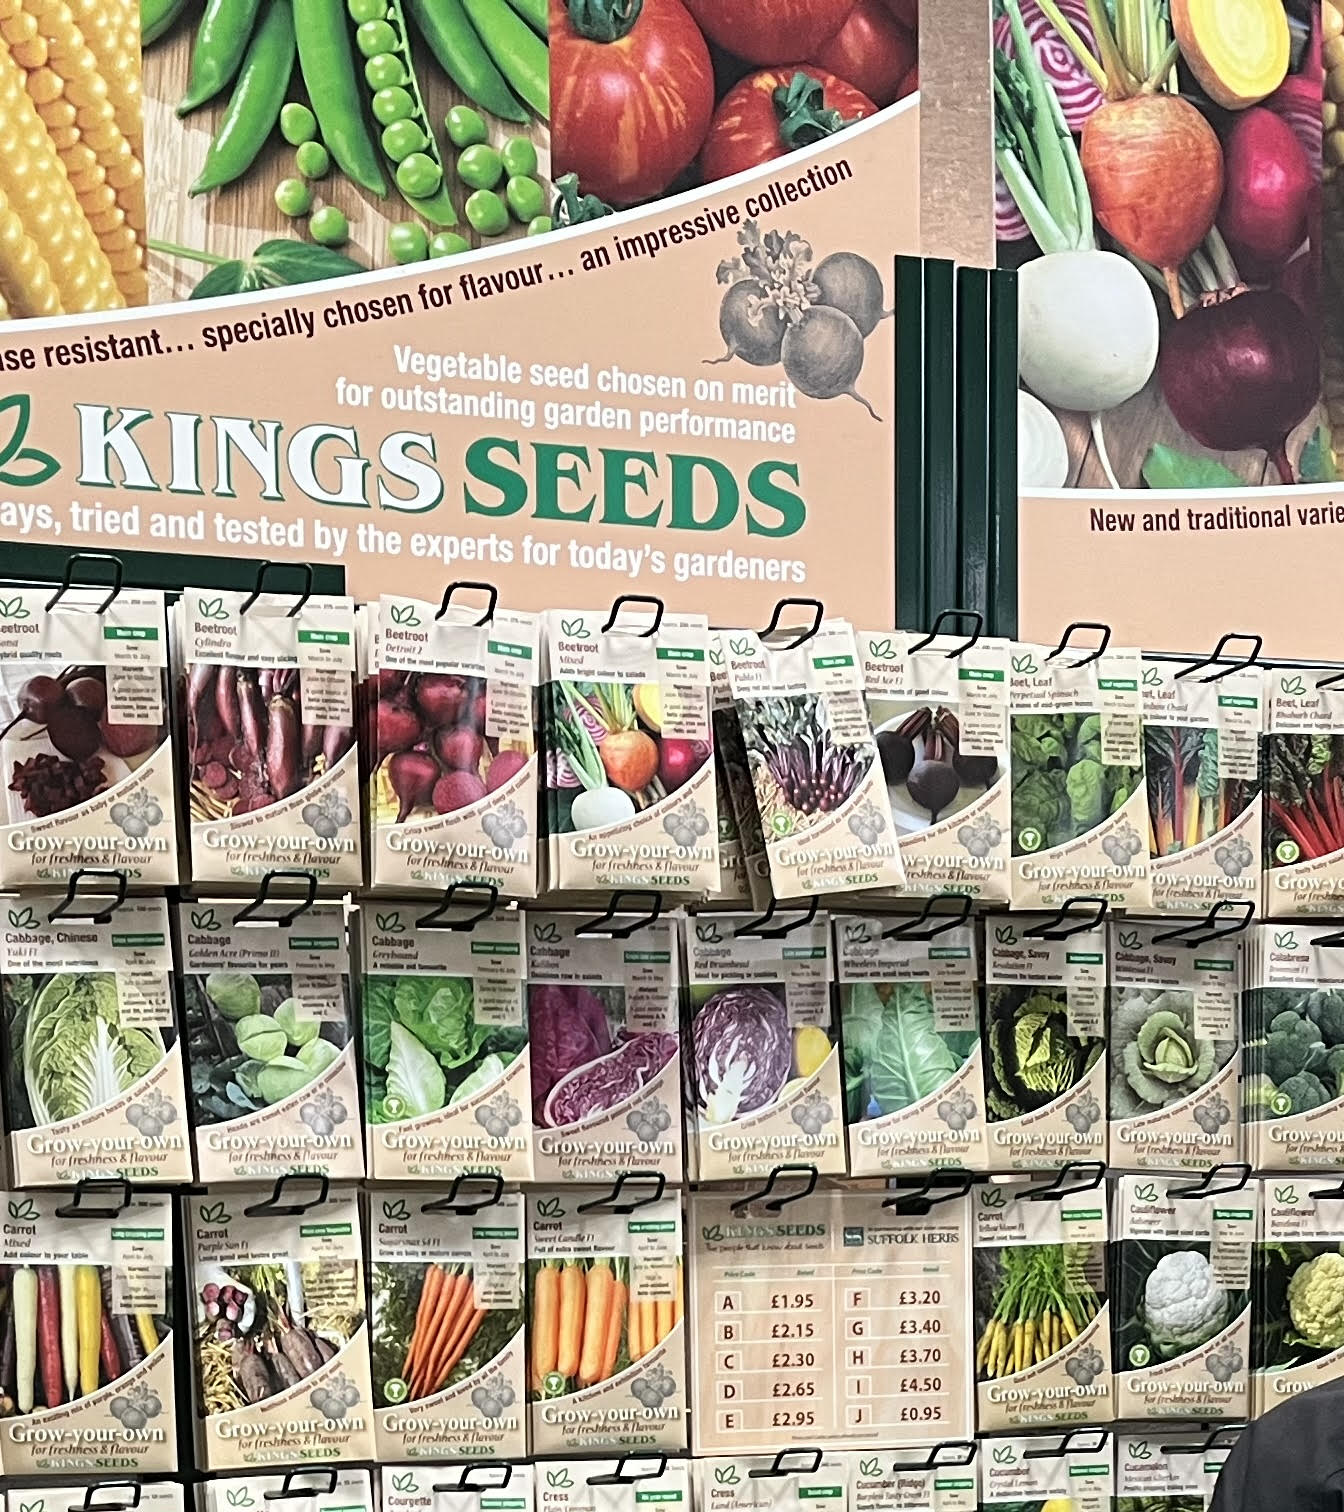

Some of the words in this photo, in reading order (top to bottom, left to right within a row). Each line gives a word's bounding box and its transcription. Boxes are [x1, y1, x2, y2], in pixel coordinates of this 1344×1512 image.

[203, 307, 316, 350] specially
[323, 294, 413, 329] chosen
[418, 284, 453, 310] for
[581, 245, 610, 273] an
[614, 204, 741, 264] impressive
[746, 156, 853, 219] collection
[393, 345, 521, 385] Vegetable
[530, 360, 589, 390] seed
[597, 366, 689, 397] chosen
[695, 379, 727, 401] on
[732, 380, 797, 409] merit
[336, 378, 374, 406] for
[381, 381, 536, 429] outstanding
[544, 397, 633, 435] garden
[640, 405, 795, 445] performance
[75, 402, 444, 512] KINGS
[463, 435, 807, 539] SEEDS
[1090, 507, 1135, 532] New
[1143, 507, 1180, 531] and
[1187, 505, 1291, 530] traditional
[70, 501, 140, 537] tried
[149, 508, 205, 541] and
[215, 512, 307, 547] tested
[313, 519, 350, 555] by
[357, 522, 402, 555] the
[410, 530, 515, 568] experts
[521, 535, 559, 566] for
[674, 549, 807, 584] gardeners
[195, 623, 237, 636] Beetroot
[1276, 698, 1301, 709] Beet,
[1304, 698, 1319, 709] Leaf
[204, 830, 354, 853] Grow-your-own
[777, 1224, 825, 1236] SEEDS
[868, 1233, 918, 1245] SUFFOLK
[922, 1232, 959, 1244] HERBS
[723, 1297, 734, 1310] A
[771, 1294, 814, 1308] £1.95
[854, 1293, 862, 1306] F
[899, 1291, 940, 1304] £3.20
[724, 1326, 734, 1339] B
[772, 1324, 814, 1338] £2.15
[853, 1322, 863, 1336] G
[899, 1320, 941, 1334] £3.40
[724, 1355, 734, 1369] C
[772, 1353, 814, 1367] £2.30
[853, 1351, 863, 1365] H
[900, 1349, 941, 1362] £3.70
[724, 1385, 735, 1398] D
[773, 1382, 814, 1397] £2.65
[900, 1378, 941, 1392] £4.50
[725, 1415, 734, 1428] E
[773, 1412, 814, 1426] £2.95
[855, 1410, 862, 1423] J
[900, 1407, 941, 1421] £0.95
